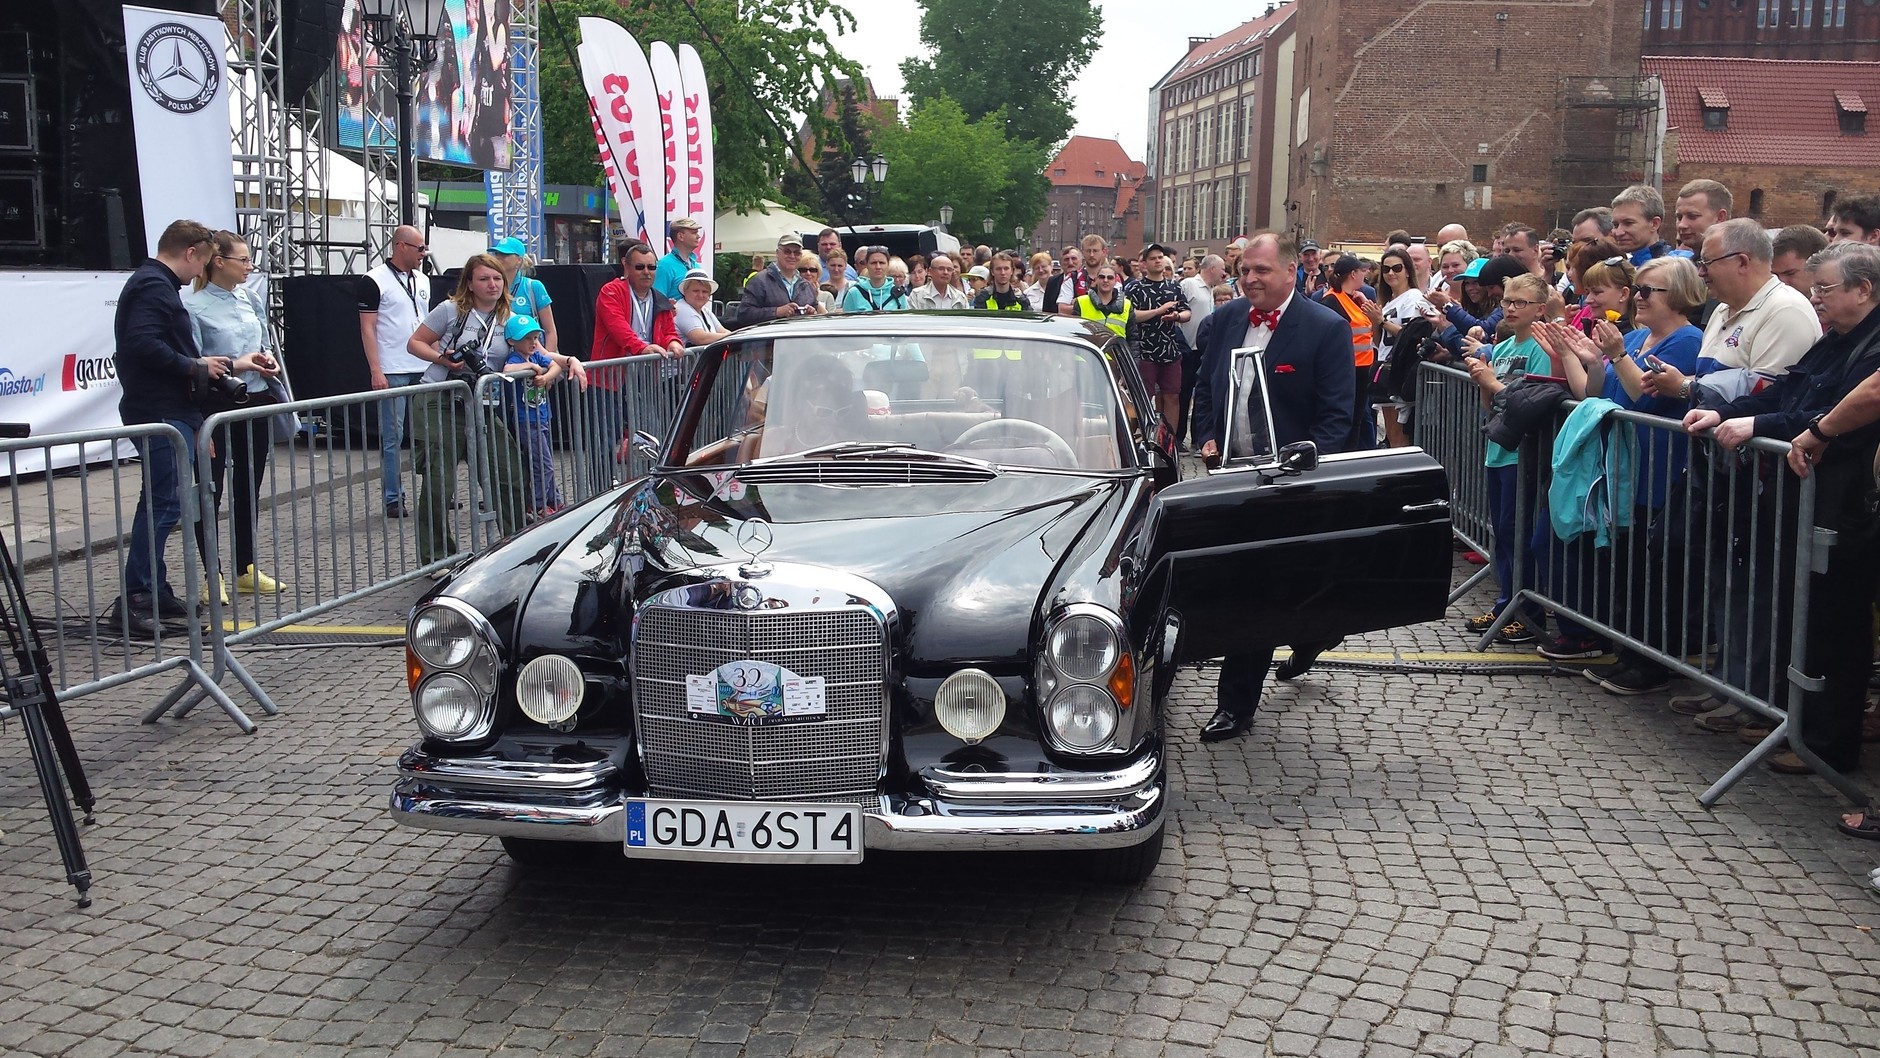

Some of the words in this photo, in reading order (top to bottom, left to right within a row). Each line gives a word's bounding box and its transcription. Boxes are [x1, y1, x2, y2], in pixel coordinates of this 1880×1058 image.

[139, 47, 148, 64] KLUB
[144, 26, 187, 47] ZABYTKOWYCH
[187, 31, 216, 71] MERCEDESÓW
[167, 100, 195, 111] POLSKA
[733, 667, 763, 688] 32
[630, 830, 644, 841] PL
[652, 807, 735, 849] GDA
[751, 810, 852, 850] 6ST4
